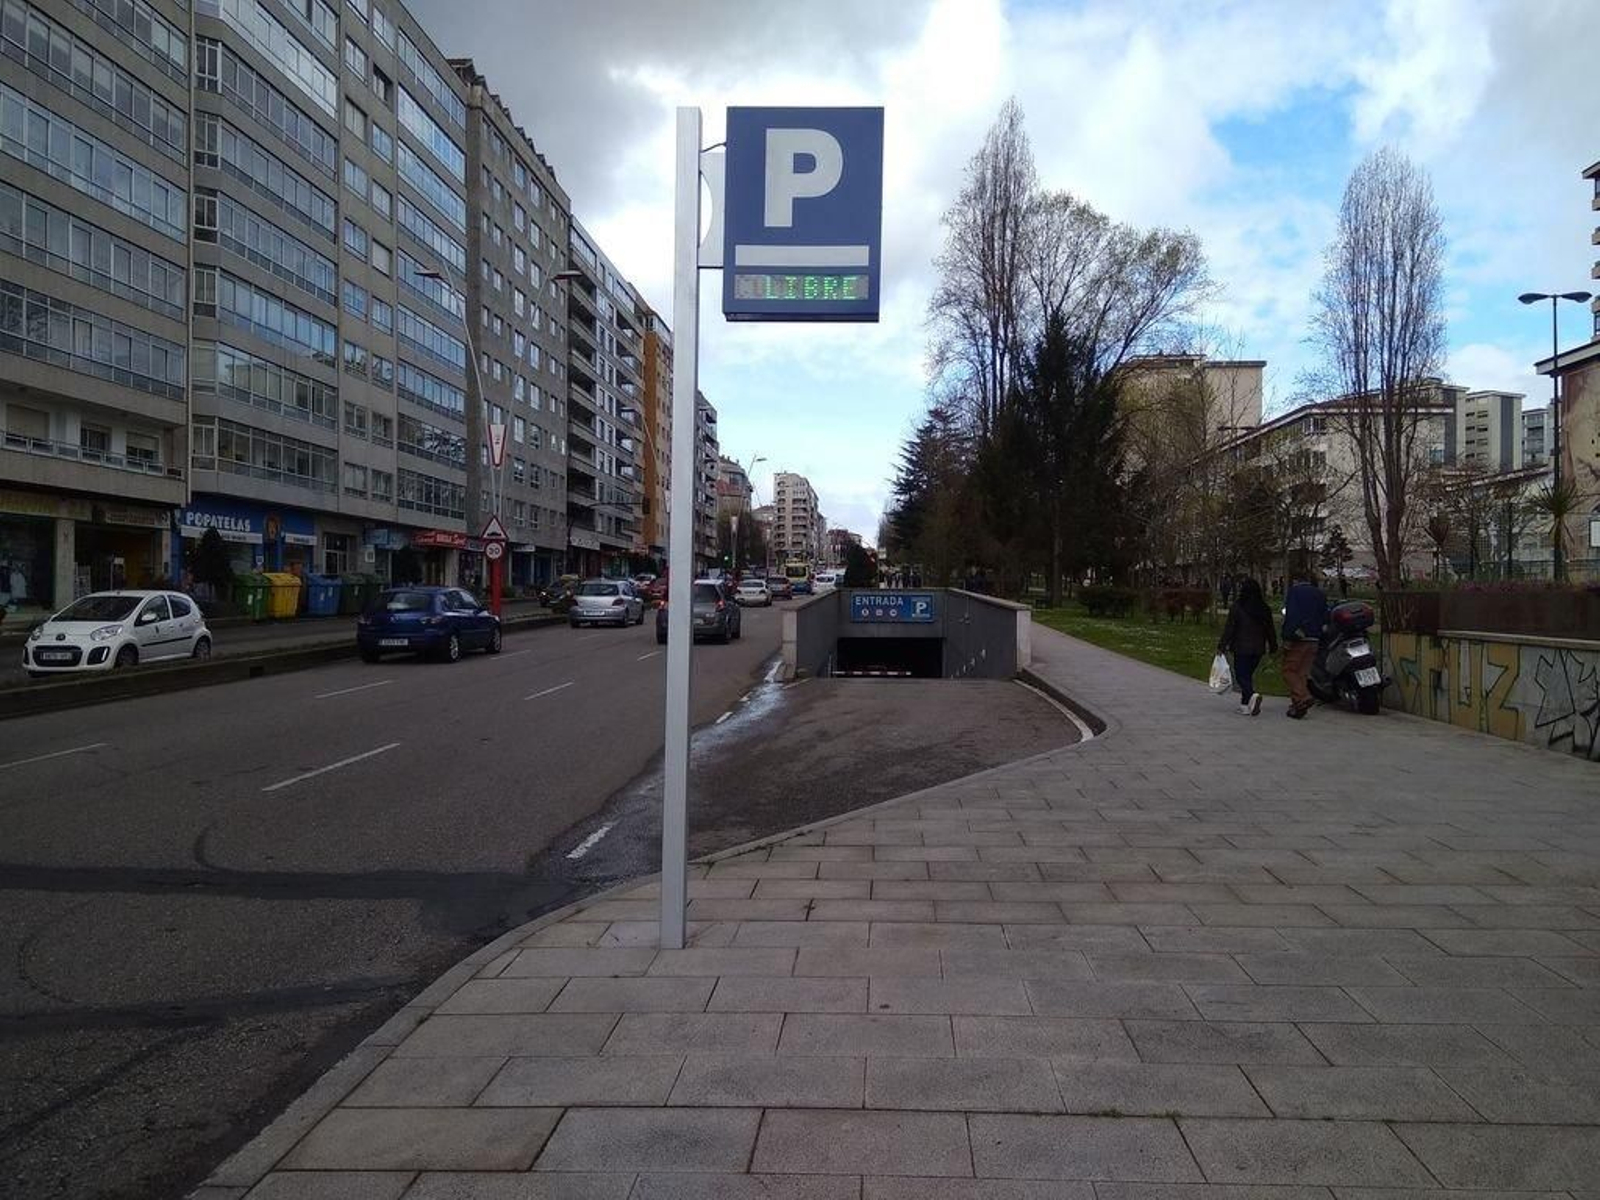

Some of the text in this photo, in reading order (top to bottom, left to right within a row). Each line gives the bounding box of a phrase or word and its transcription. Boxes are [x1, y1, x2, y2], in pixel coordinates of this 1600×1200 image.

[764, 127, 844, 228] P
[765, 276, 858, 300] LIBRE
[855, 595, 904, 607] ENTRADA
[916, 602, 927, 614] P
